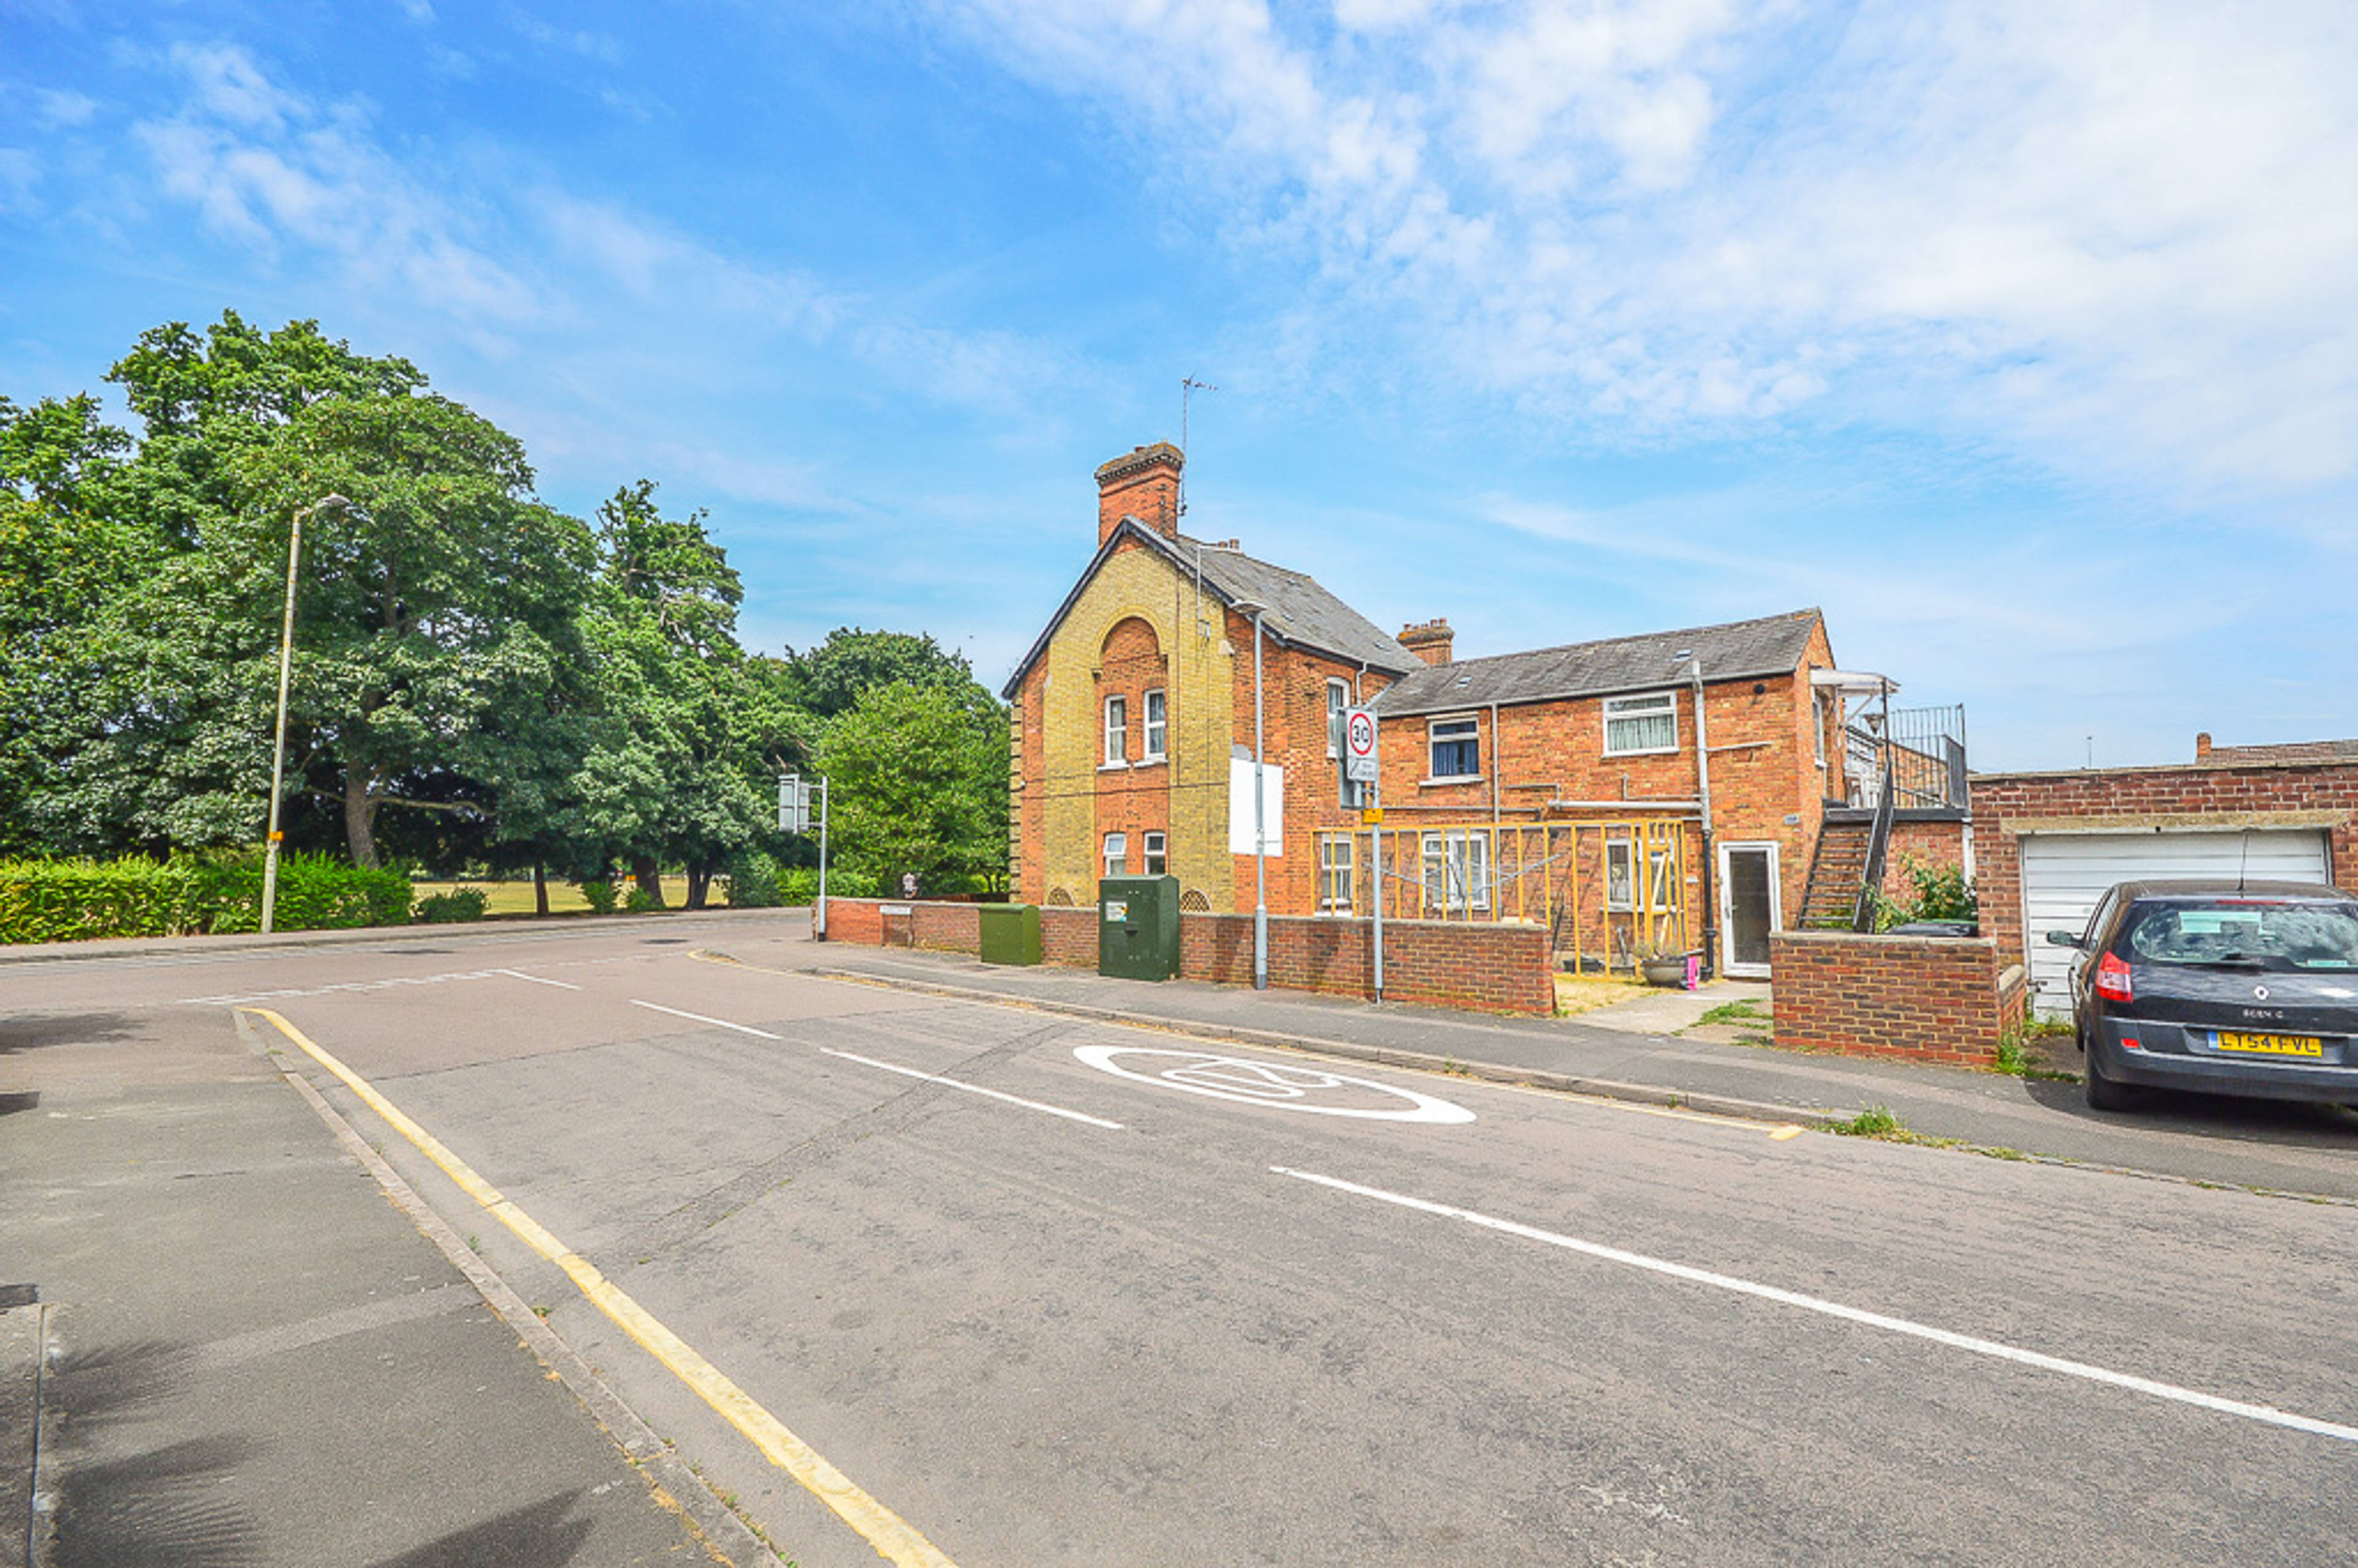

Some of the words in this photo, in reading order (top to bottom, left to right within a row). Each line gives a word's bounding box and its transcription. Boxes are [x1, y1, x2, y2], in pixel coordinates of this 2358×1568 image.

[1352, 725, 1370, 742] 30
[2221, 1034, 2271, 1049] LT54
[2279, 1038, 2317, 1052] FVL
